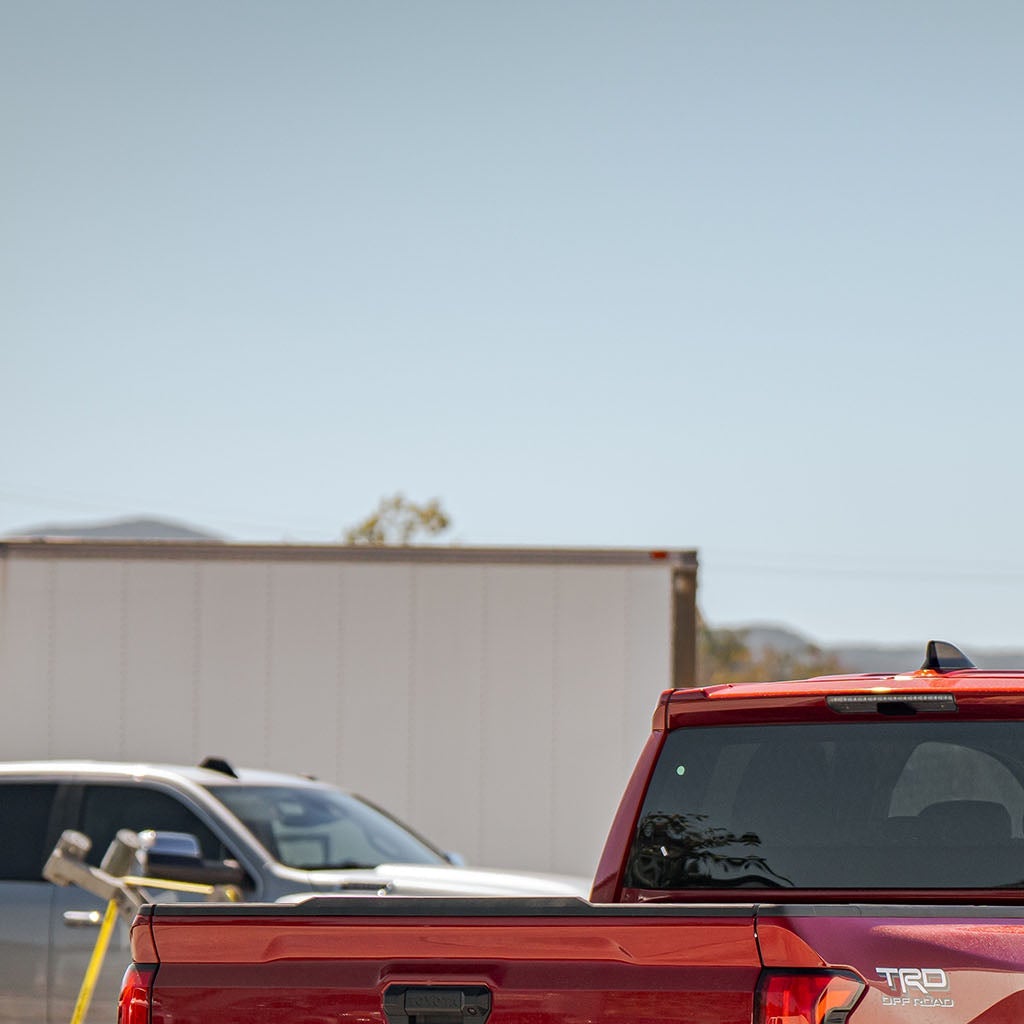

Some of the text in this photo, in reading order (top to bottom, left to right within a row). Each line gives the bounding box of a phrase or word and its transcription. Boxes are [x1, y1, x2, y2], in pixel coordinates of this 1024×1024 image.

[875, 967, 948, 994] TRD
[881, 997, 954, 1008] OFF ROAD
